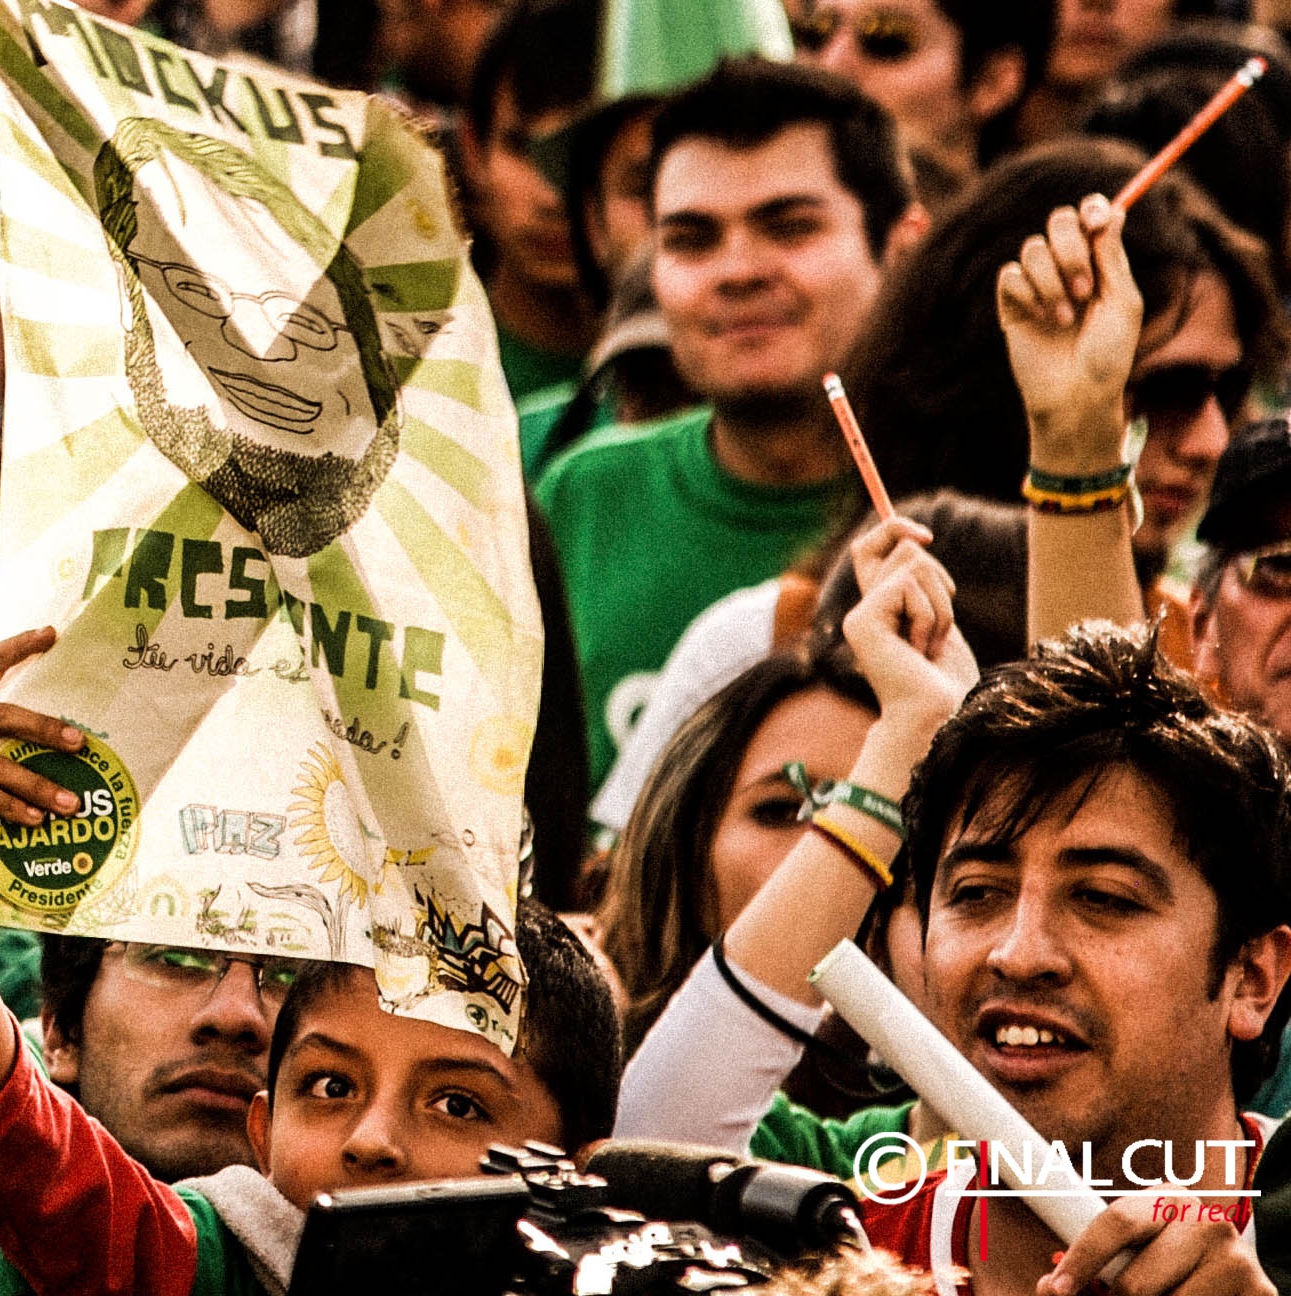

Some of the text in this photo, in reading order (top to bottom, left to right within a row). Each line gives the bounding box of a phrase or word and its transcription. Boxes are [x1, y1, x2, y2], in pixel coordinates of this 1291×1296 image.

[184, 642, 262, 677] vida
[77, 743, 111, 773] ace
[108, 771, 125, 794] la
[115, 796, 134, 861] fuerza
[178, 803, 288, 860] PAZ
[22, 857, 73, 878] Verde
[7, 877, 105, 908] Presidente
